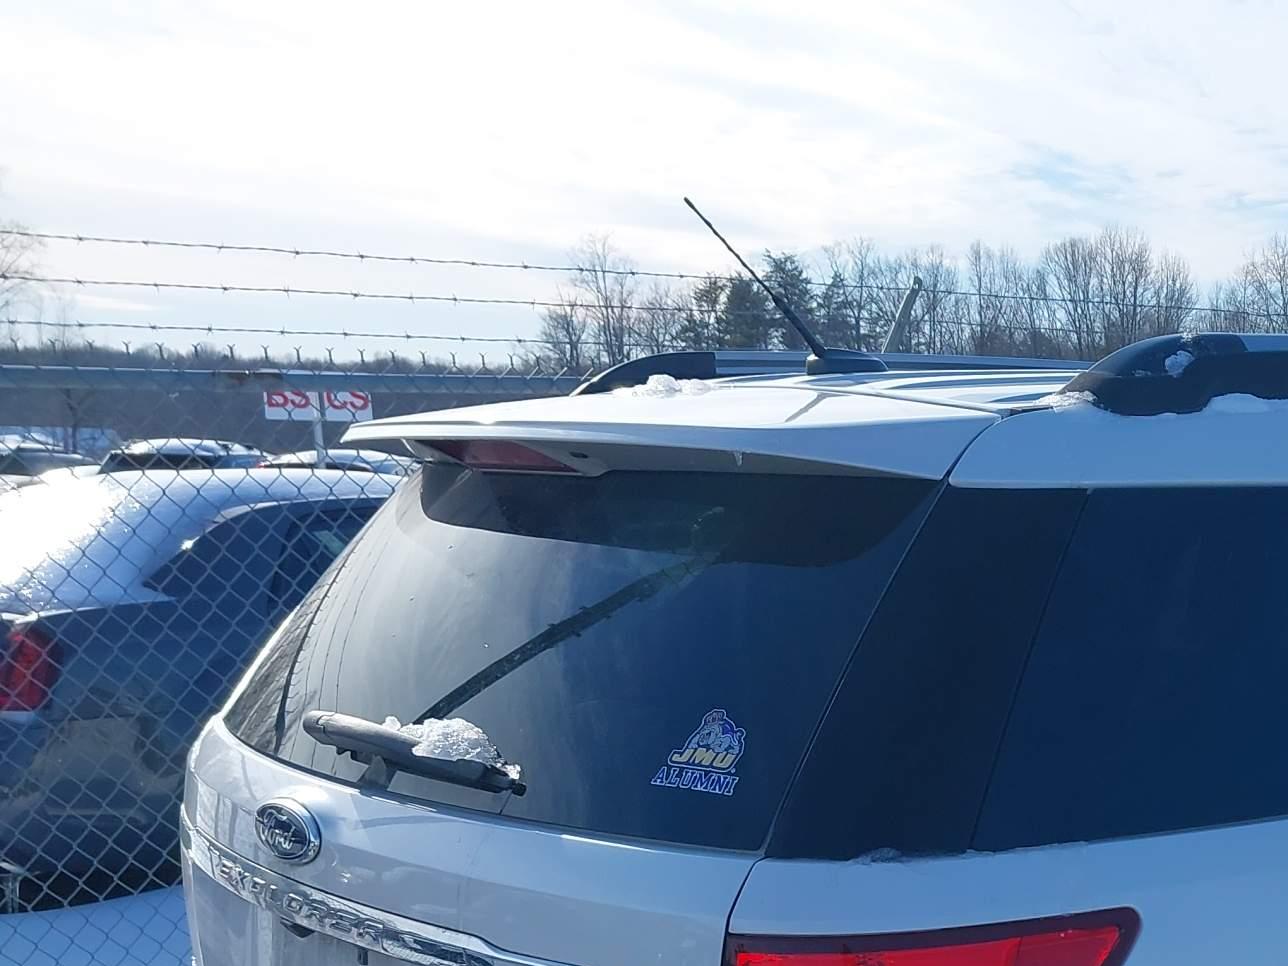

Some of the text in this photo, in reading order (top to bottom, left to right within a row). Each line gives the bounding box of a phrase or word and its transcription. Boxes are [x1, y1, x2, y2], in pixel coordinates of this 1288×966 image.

[671, 747, 737, 768] JMU
[650, 766, 739, 796] ALUMNI
[260, 809, 296, 850] Ford
